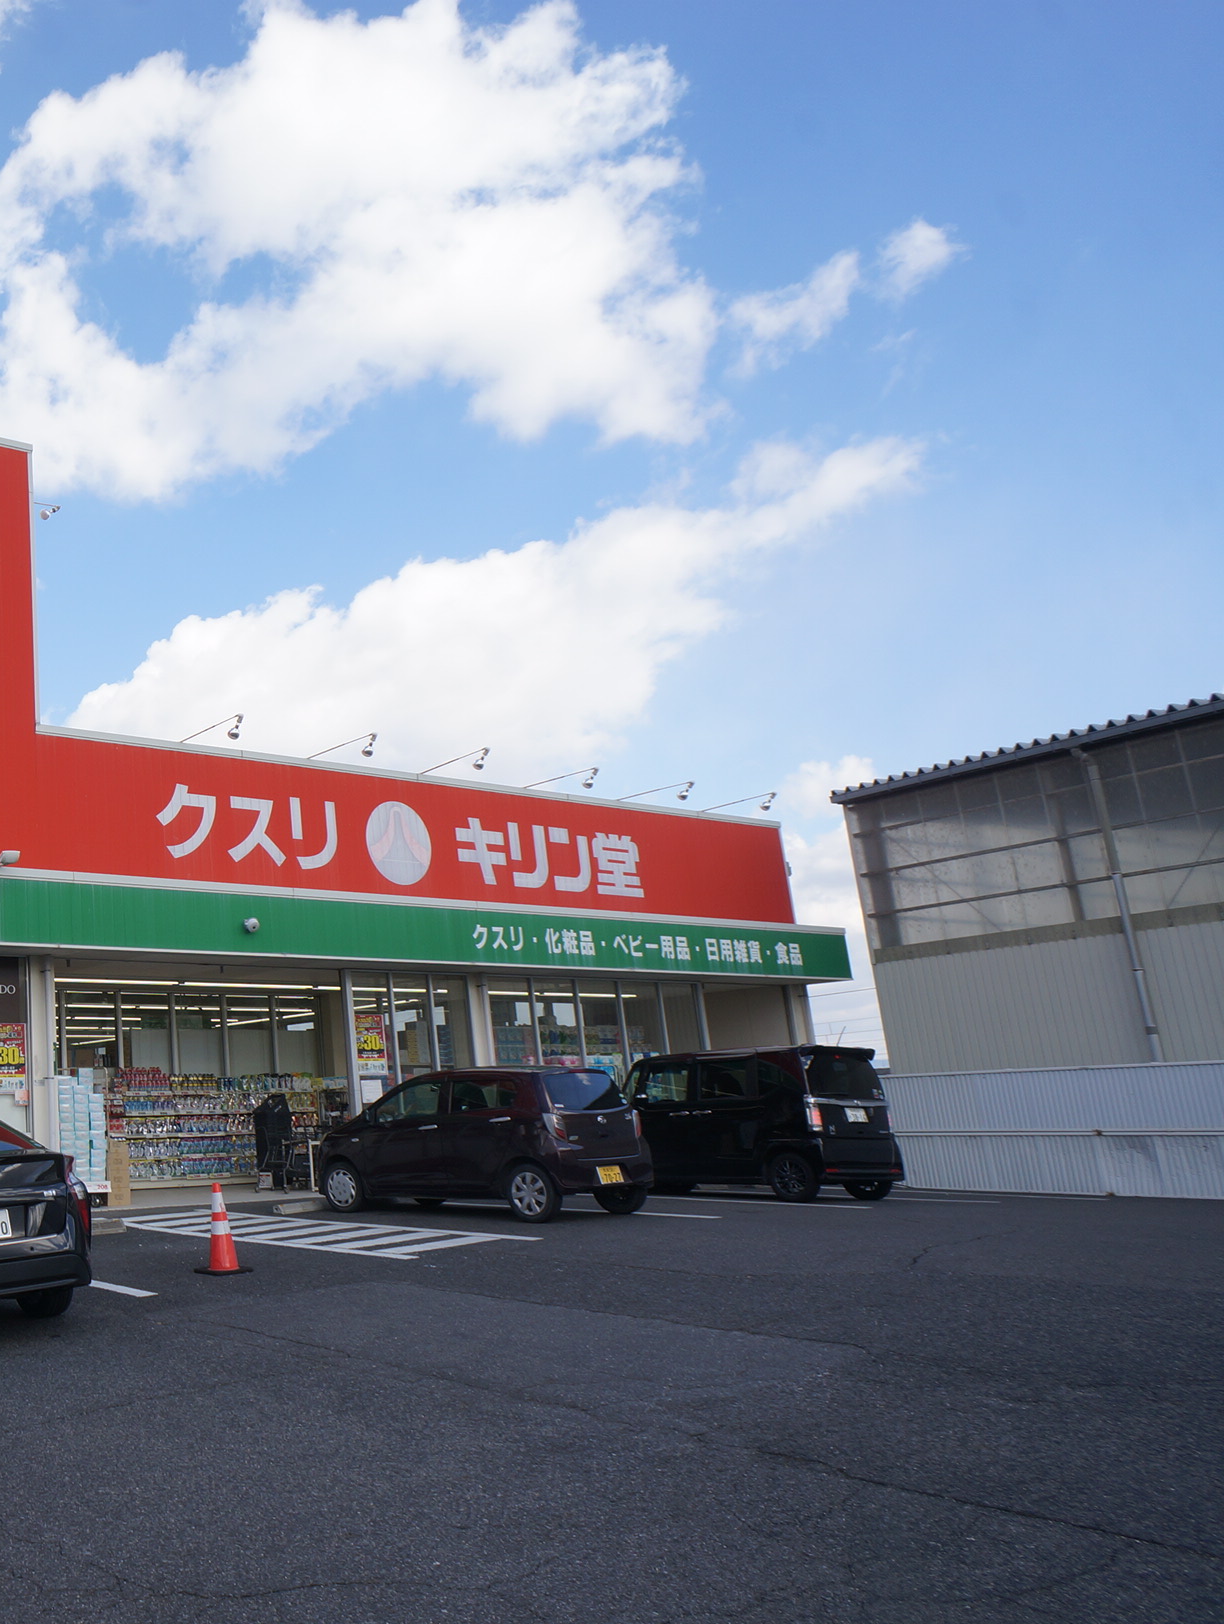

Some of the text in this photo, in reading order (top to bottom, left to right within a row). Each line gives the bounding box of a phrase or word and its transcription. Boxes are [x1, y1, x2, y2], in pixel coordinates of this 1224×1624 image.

[156, 783, 338, 870] クスリ
[455, 817, 645, 898] キリン堂
